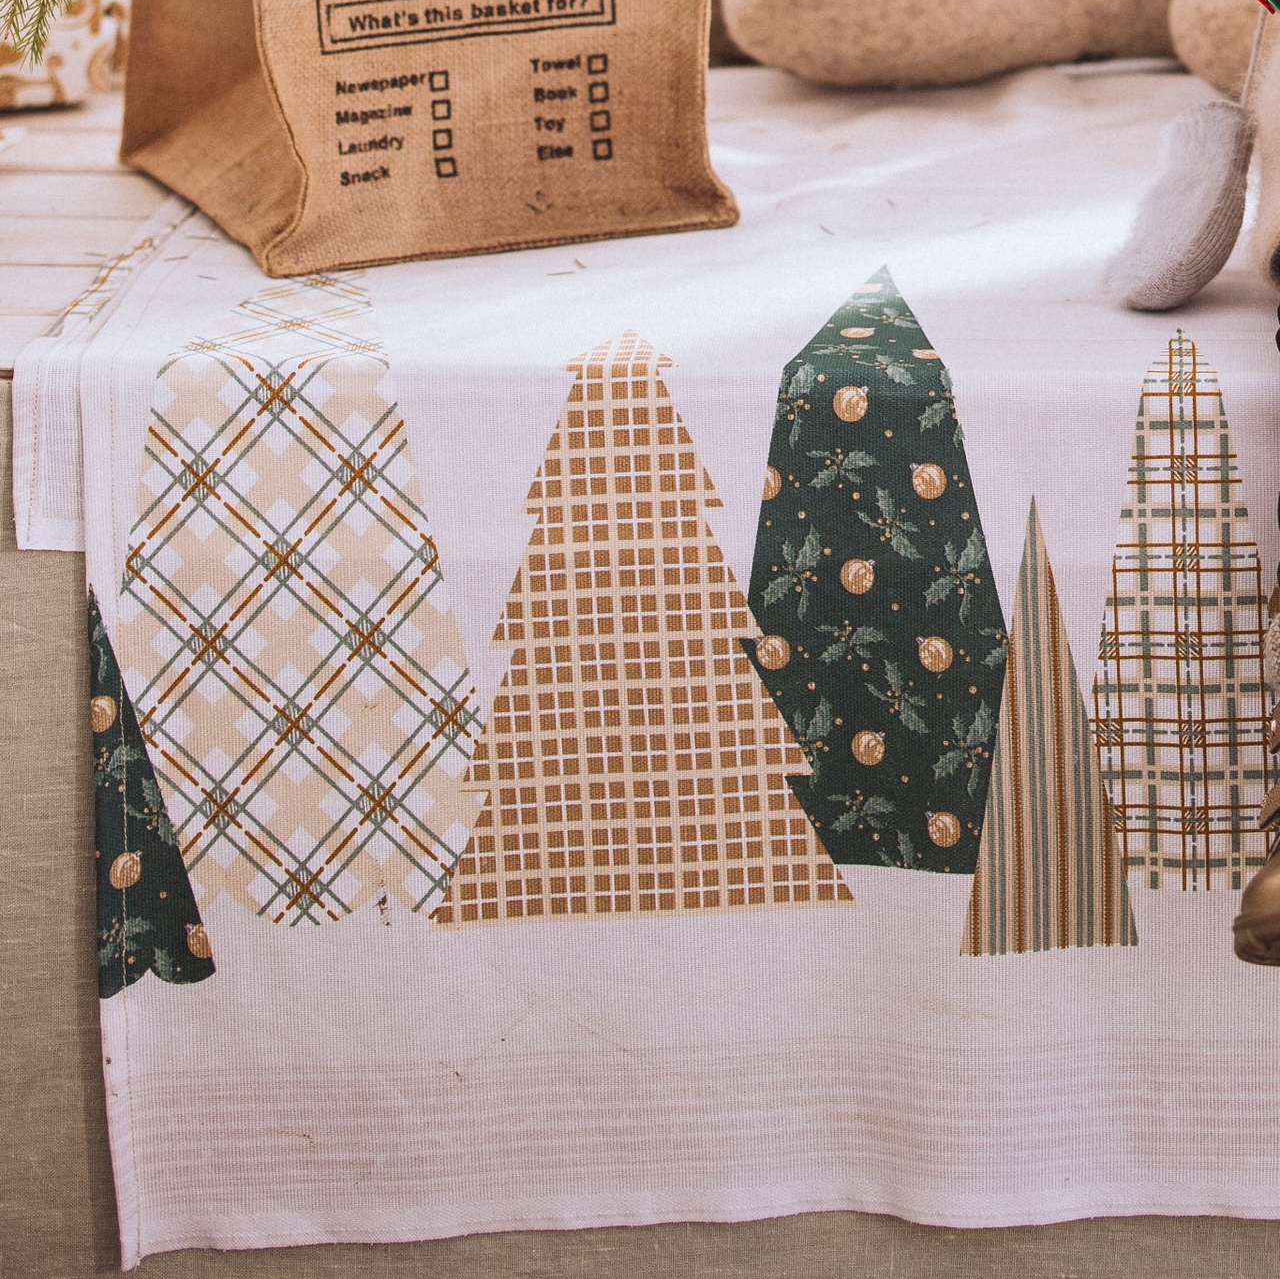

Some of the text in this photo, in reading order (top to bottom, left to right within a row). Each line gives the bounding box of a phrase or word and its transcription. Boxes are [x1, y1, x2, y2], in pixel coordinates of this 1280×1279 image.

[347, 10, 420, 33] What's
[424, 6, 464, 25] this
[529, 54, 582, 74] Towel
[335, 71, 426, 96] Newspaper
[533, 86, 578, 103] Book
[334, 104, 414, 126] Magazine
[533, 116, 566, 133] Toy
[337, 134, 405, 156] Laundry
[536, 145, 575, 162] Else
[339, 165, 392, 188] Snack
